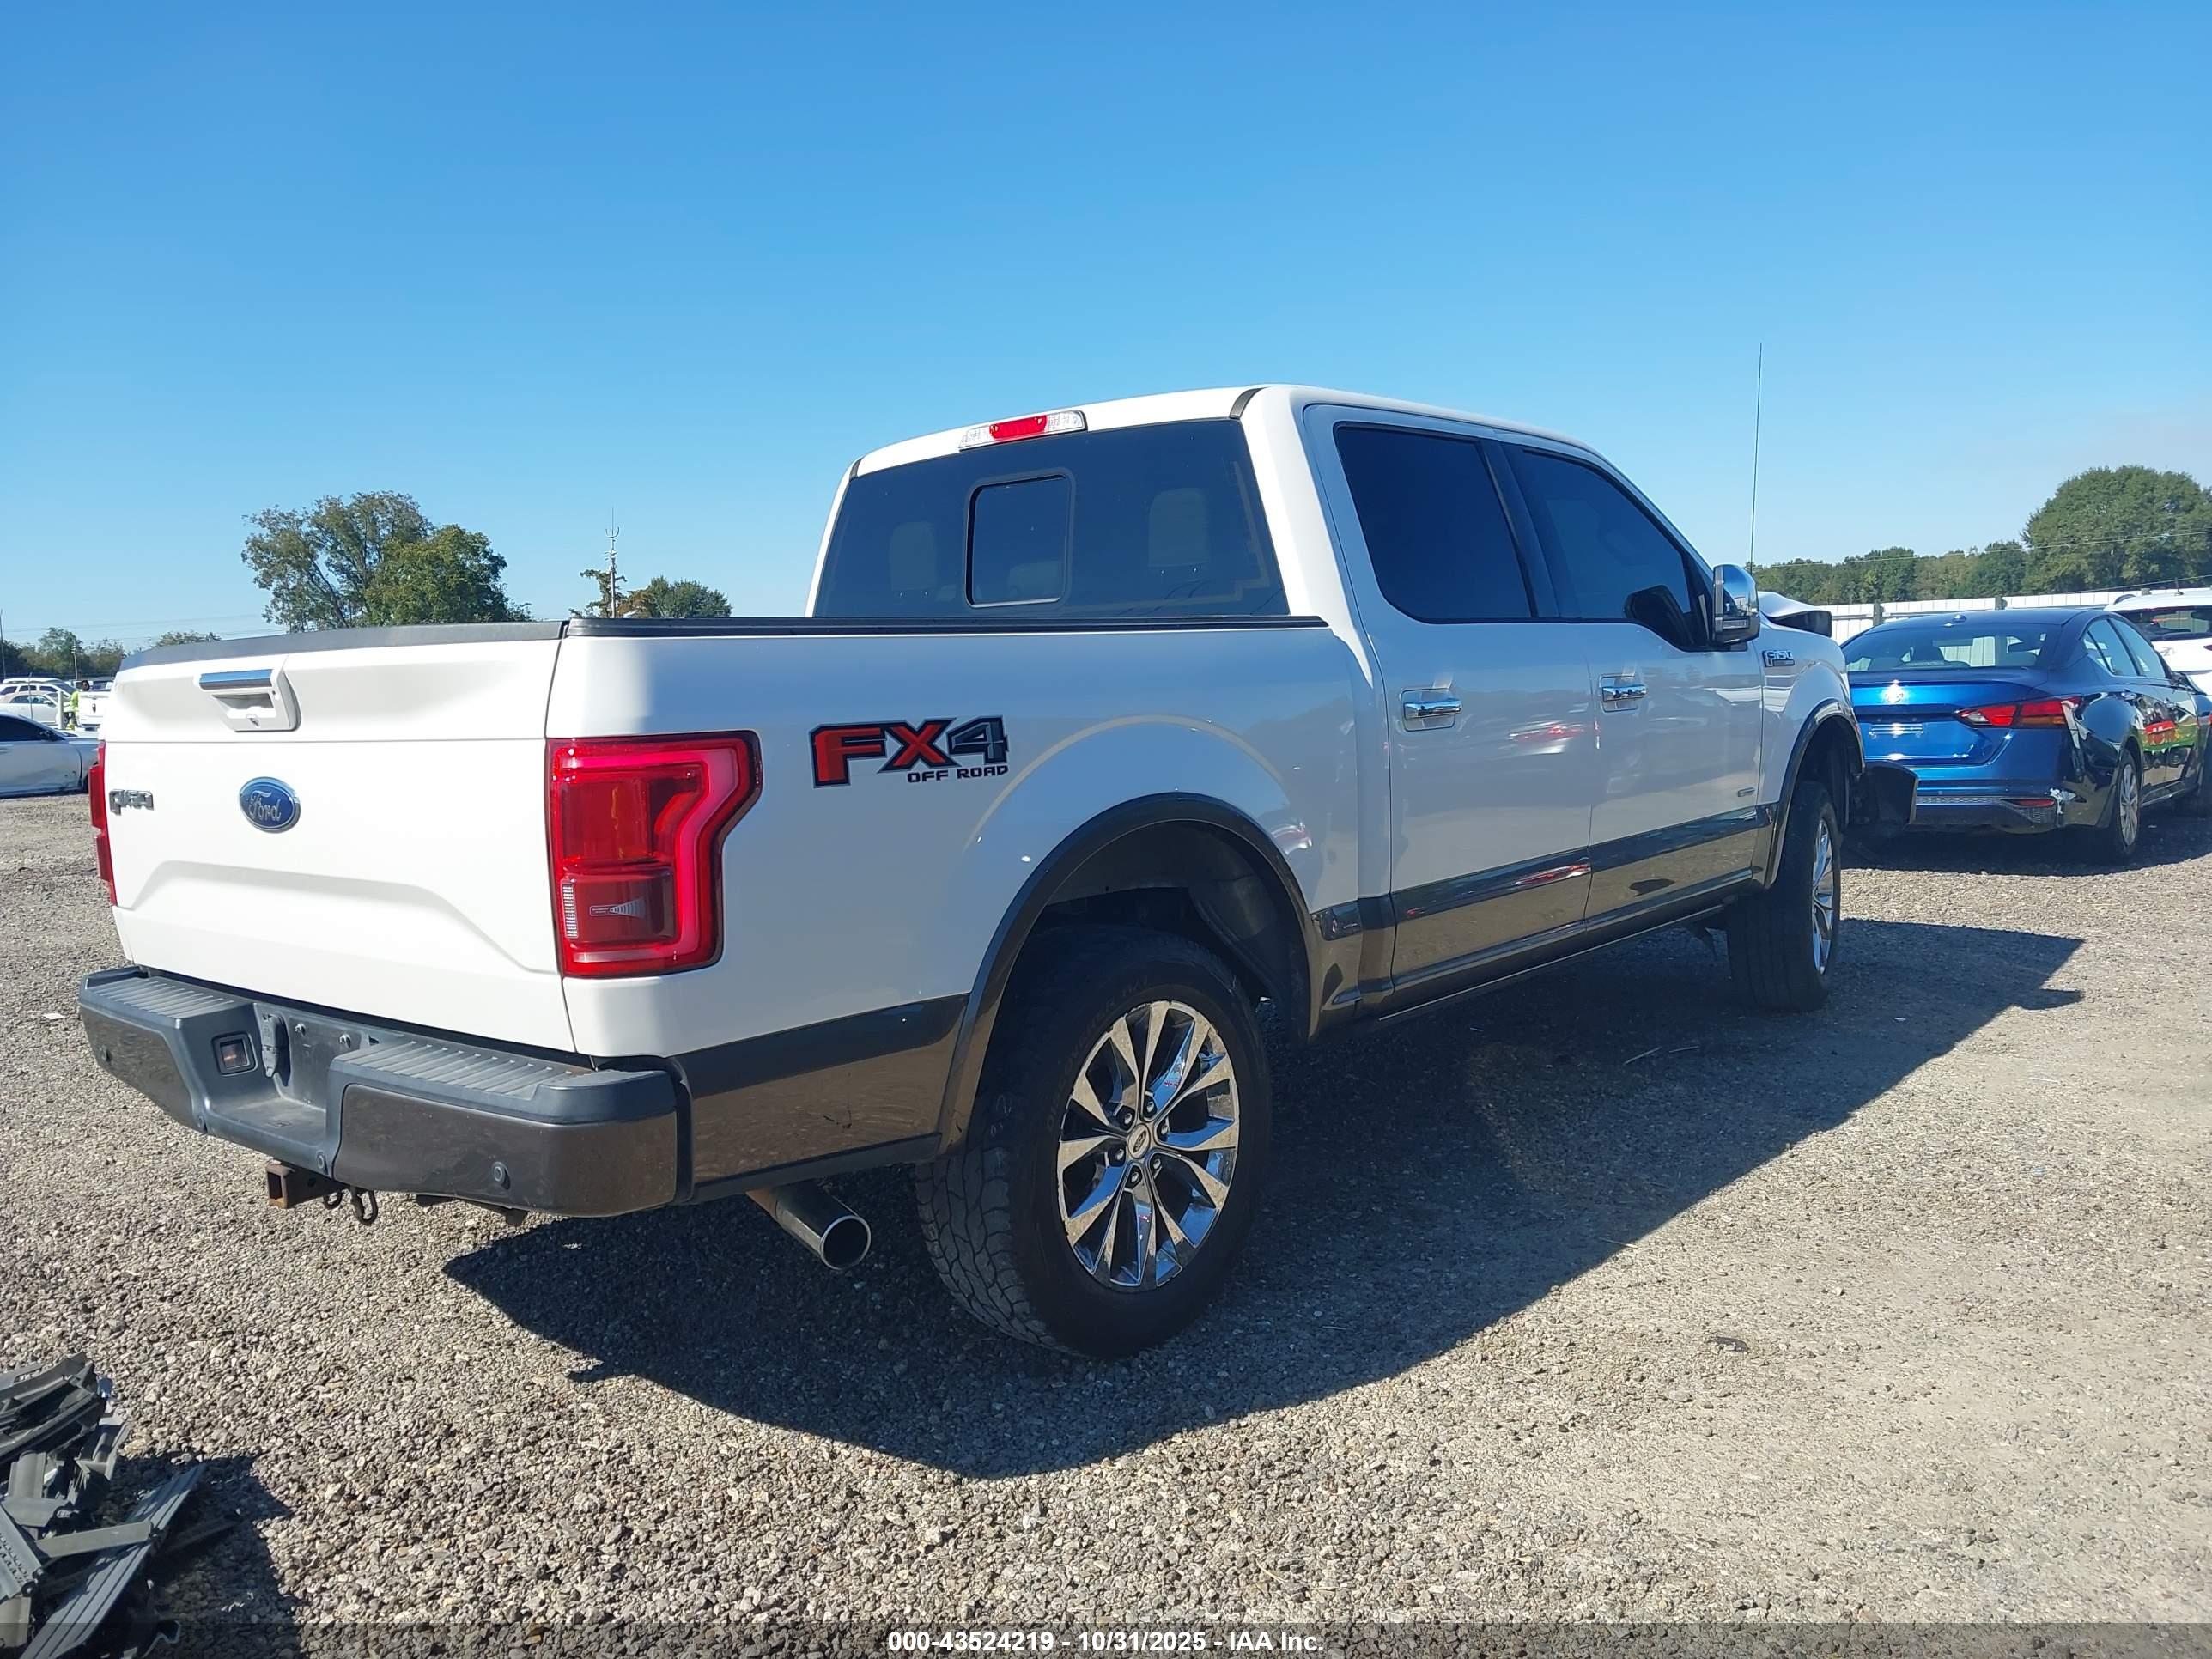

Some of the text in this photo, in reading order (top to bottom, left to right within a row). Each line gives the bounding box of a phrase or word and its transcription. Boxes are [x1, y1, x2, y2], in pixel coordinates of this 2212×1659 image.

[809, 715, 1009, 787] FX4
[907, 765, 1009, 783] OFF ROAD
[248, 790, 282, 821] Ford
